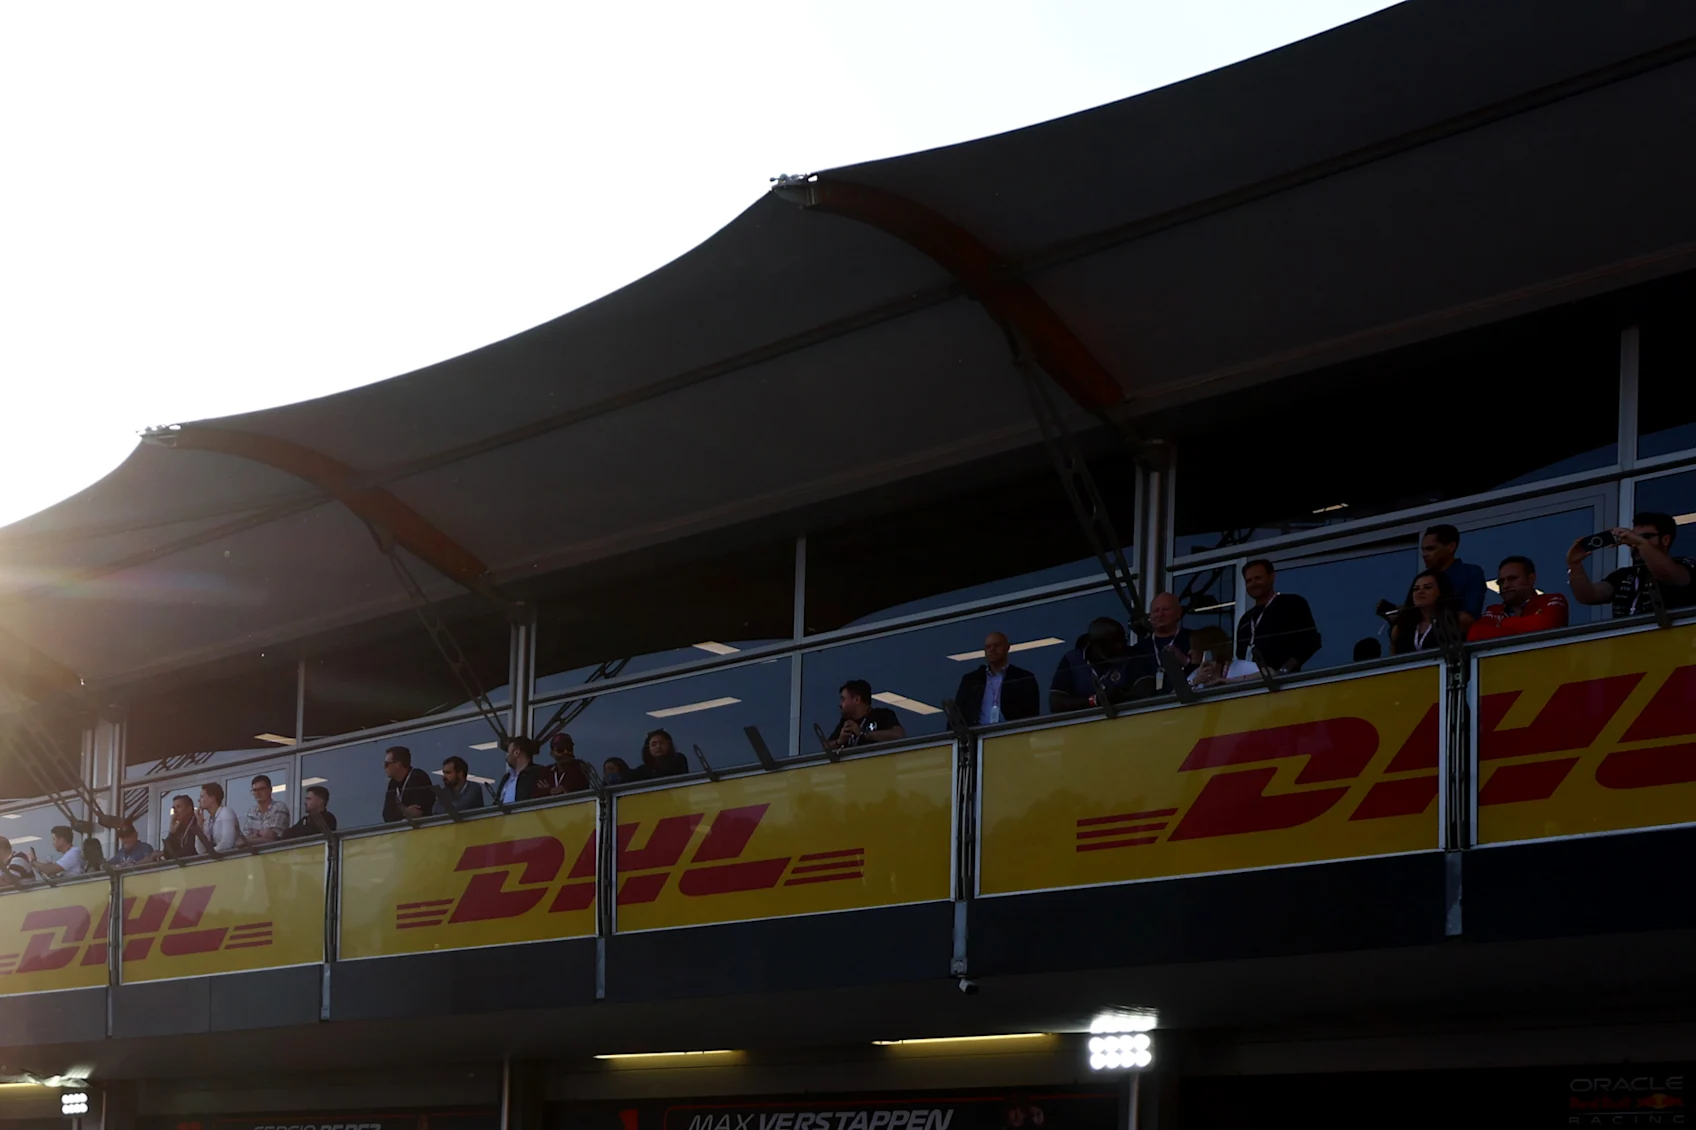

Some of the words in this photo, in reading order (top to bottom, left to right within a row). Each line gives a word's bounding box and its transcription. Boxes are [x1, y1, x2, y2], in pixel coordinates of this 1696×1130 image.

[448, 803, 791, 924] DHL
[16, 882, 229, 974] DHL
[1569, 1075, 1685, 1092] ORACLE
[1568, 1115, 1686, 1125] RACING
